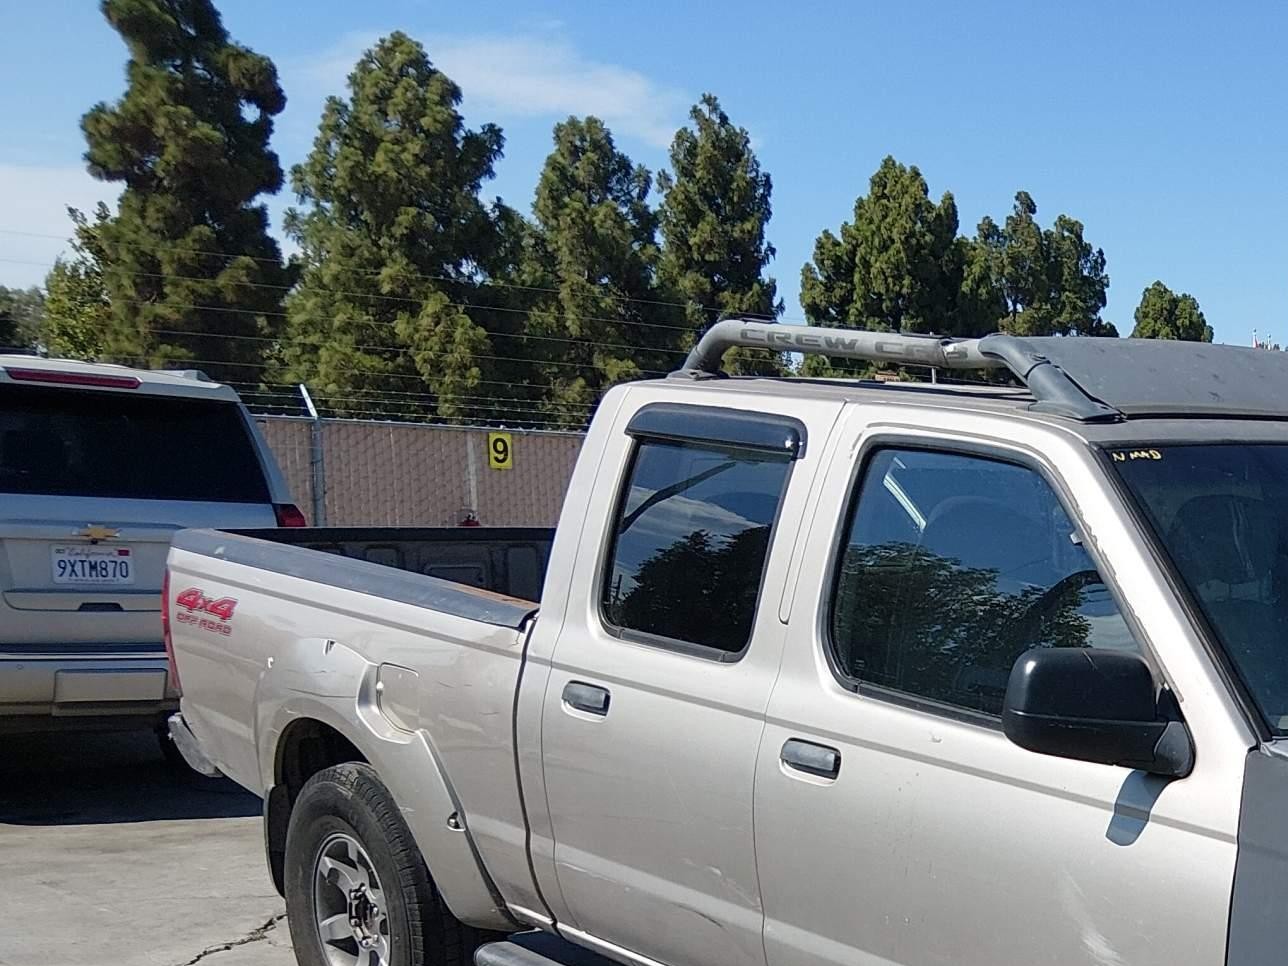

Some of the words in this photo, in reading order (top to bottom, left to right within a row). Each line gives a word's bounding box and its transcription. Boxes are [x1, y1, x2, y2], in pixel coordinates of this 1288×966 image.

[740, 328, 858, 351] CREW
[492, 437, 509, 464] 9
[57, 559, 129, 578] 9XTM870
